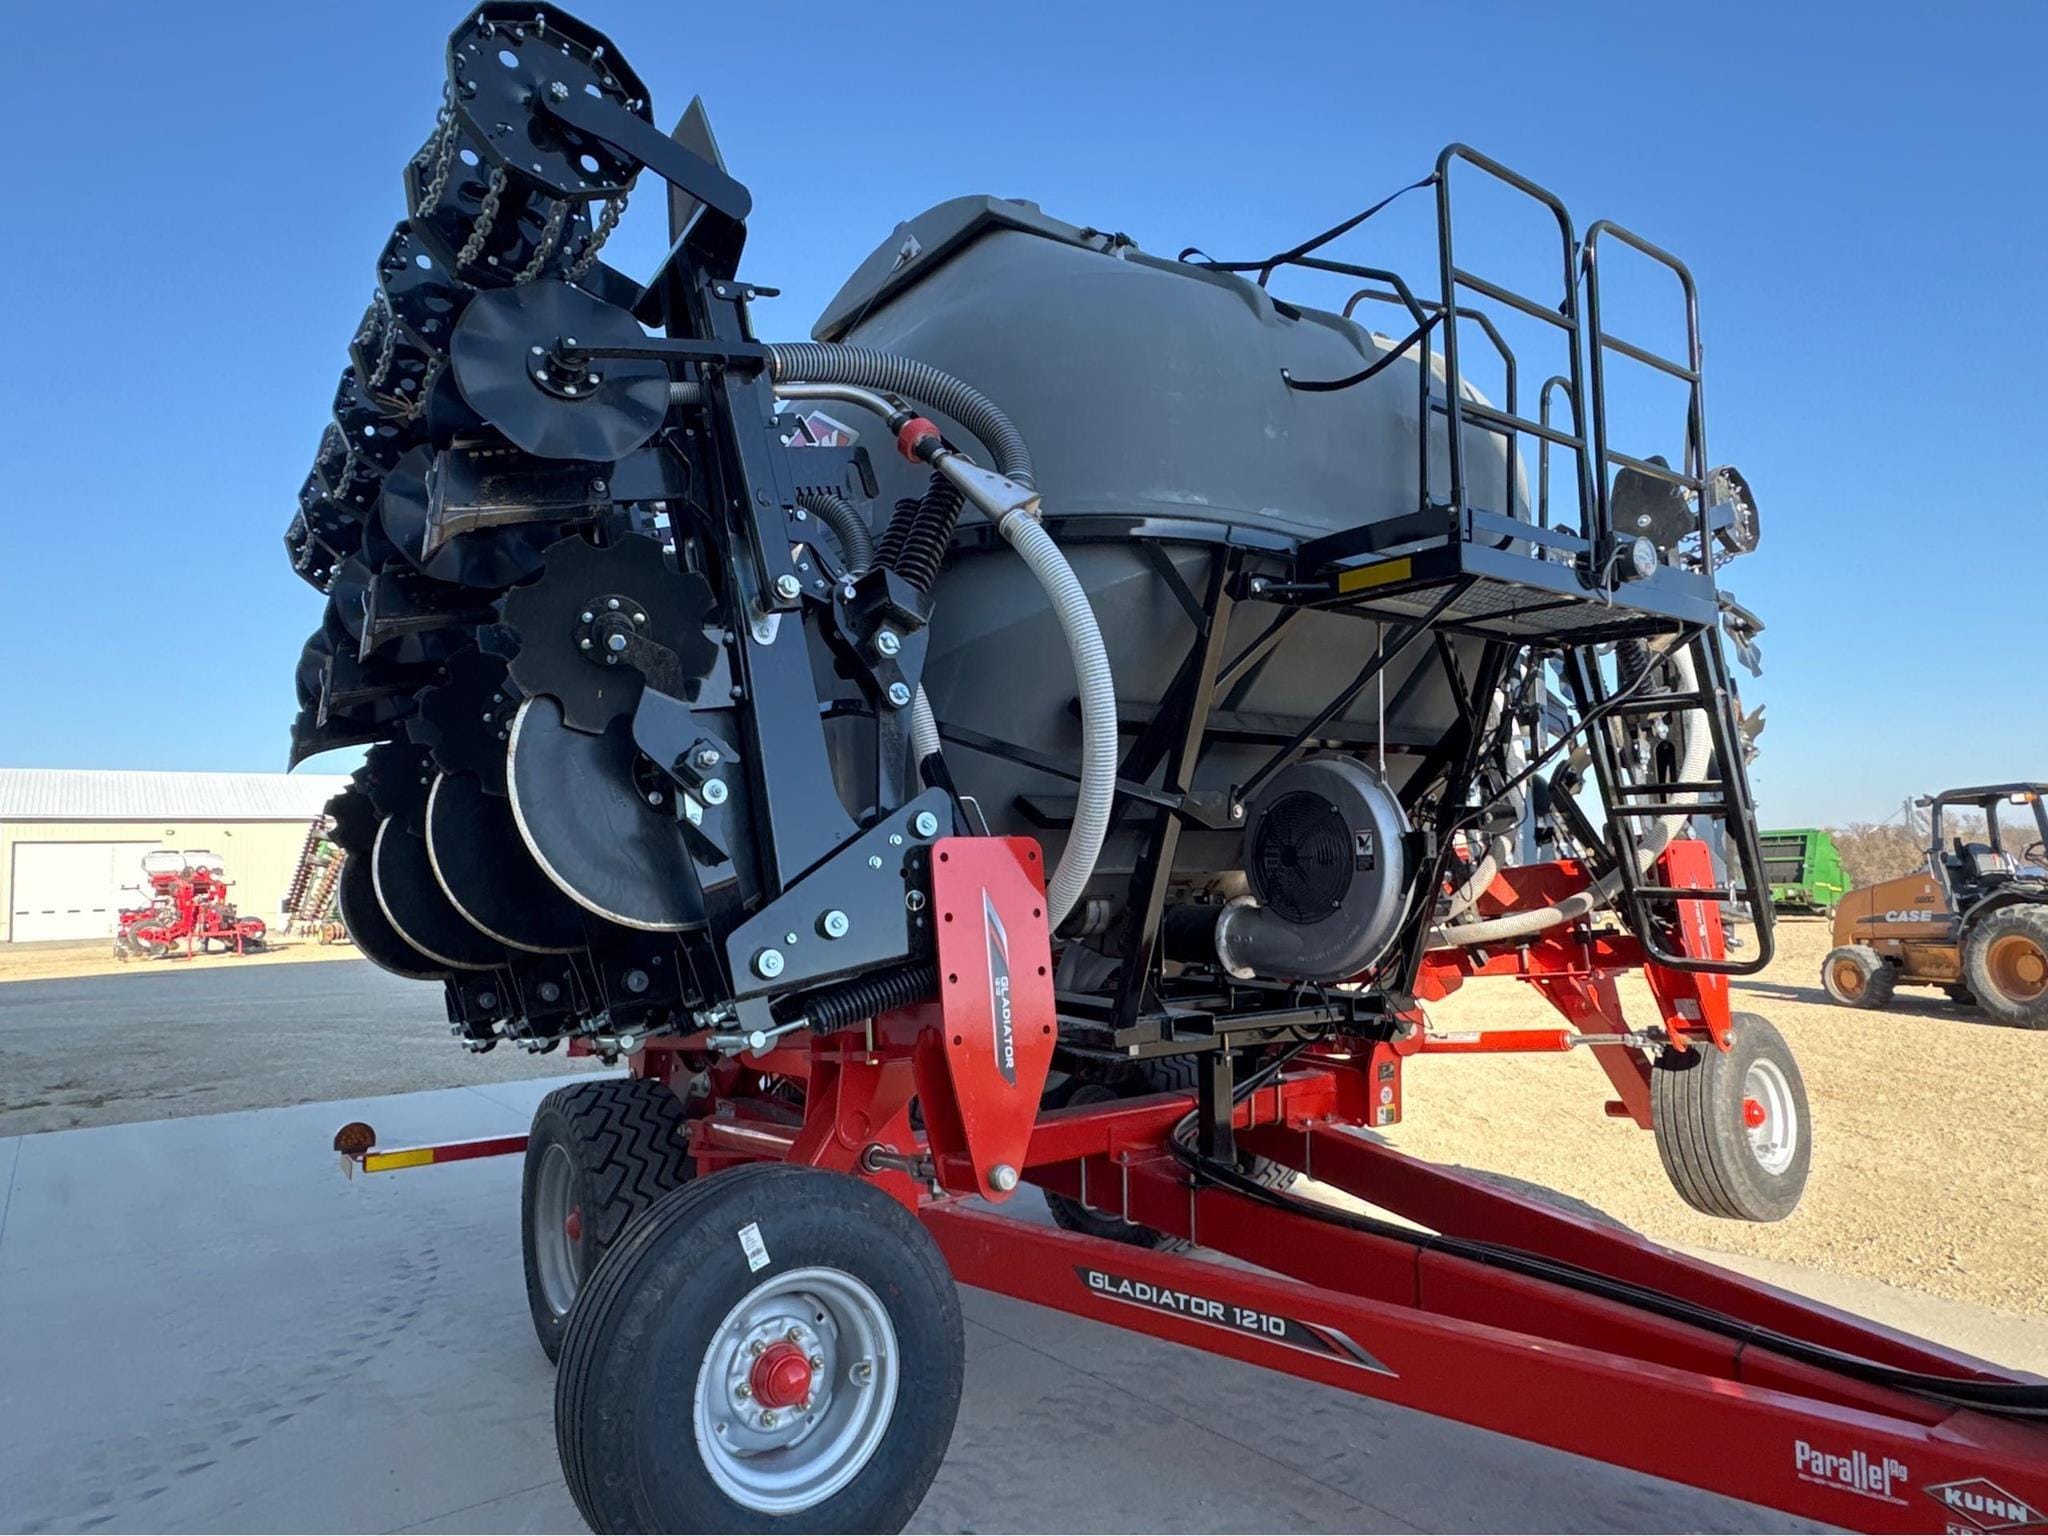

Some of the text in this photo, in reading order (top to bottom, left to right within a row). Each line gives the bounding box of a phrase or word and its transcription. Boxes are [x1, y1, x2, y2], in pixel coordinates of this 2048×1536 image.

[1885, 909, 1932, 922] CASE
[1000, 975, 1015, 1069] GLADIATOR
[1088, 1270, 1286, 1336] GLADIATOR 1210
[1944, 1487, 2028, 1523] KUHN
